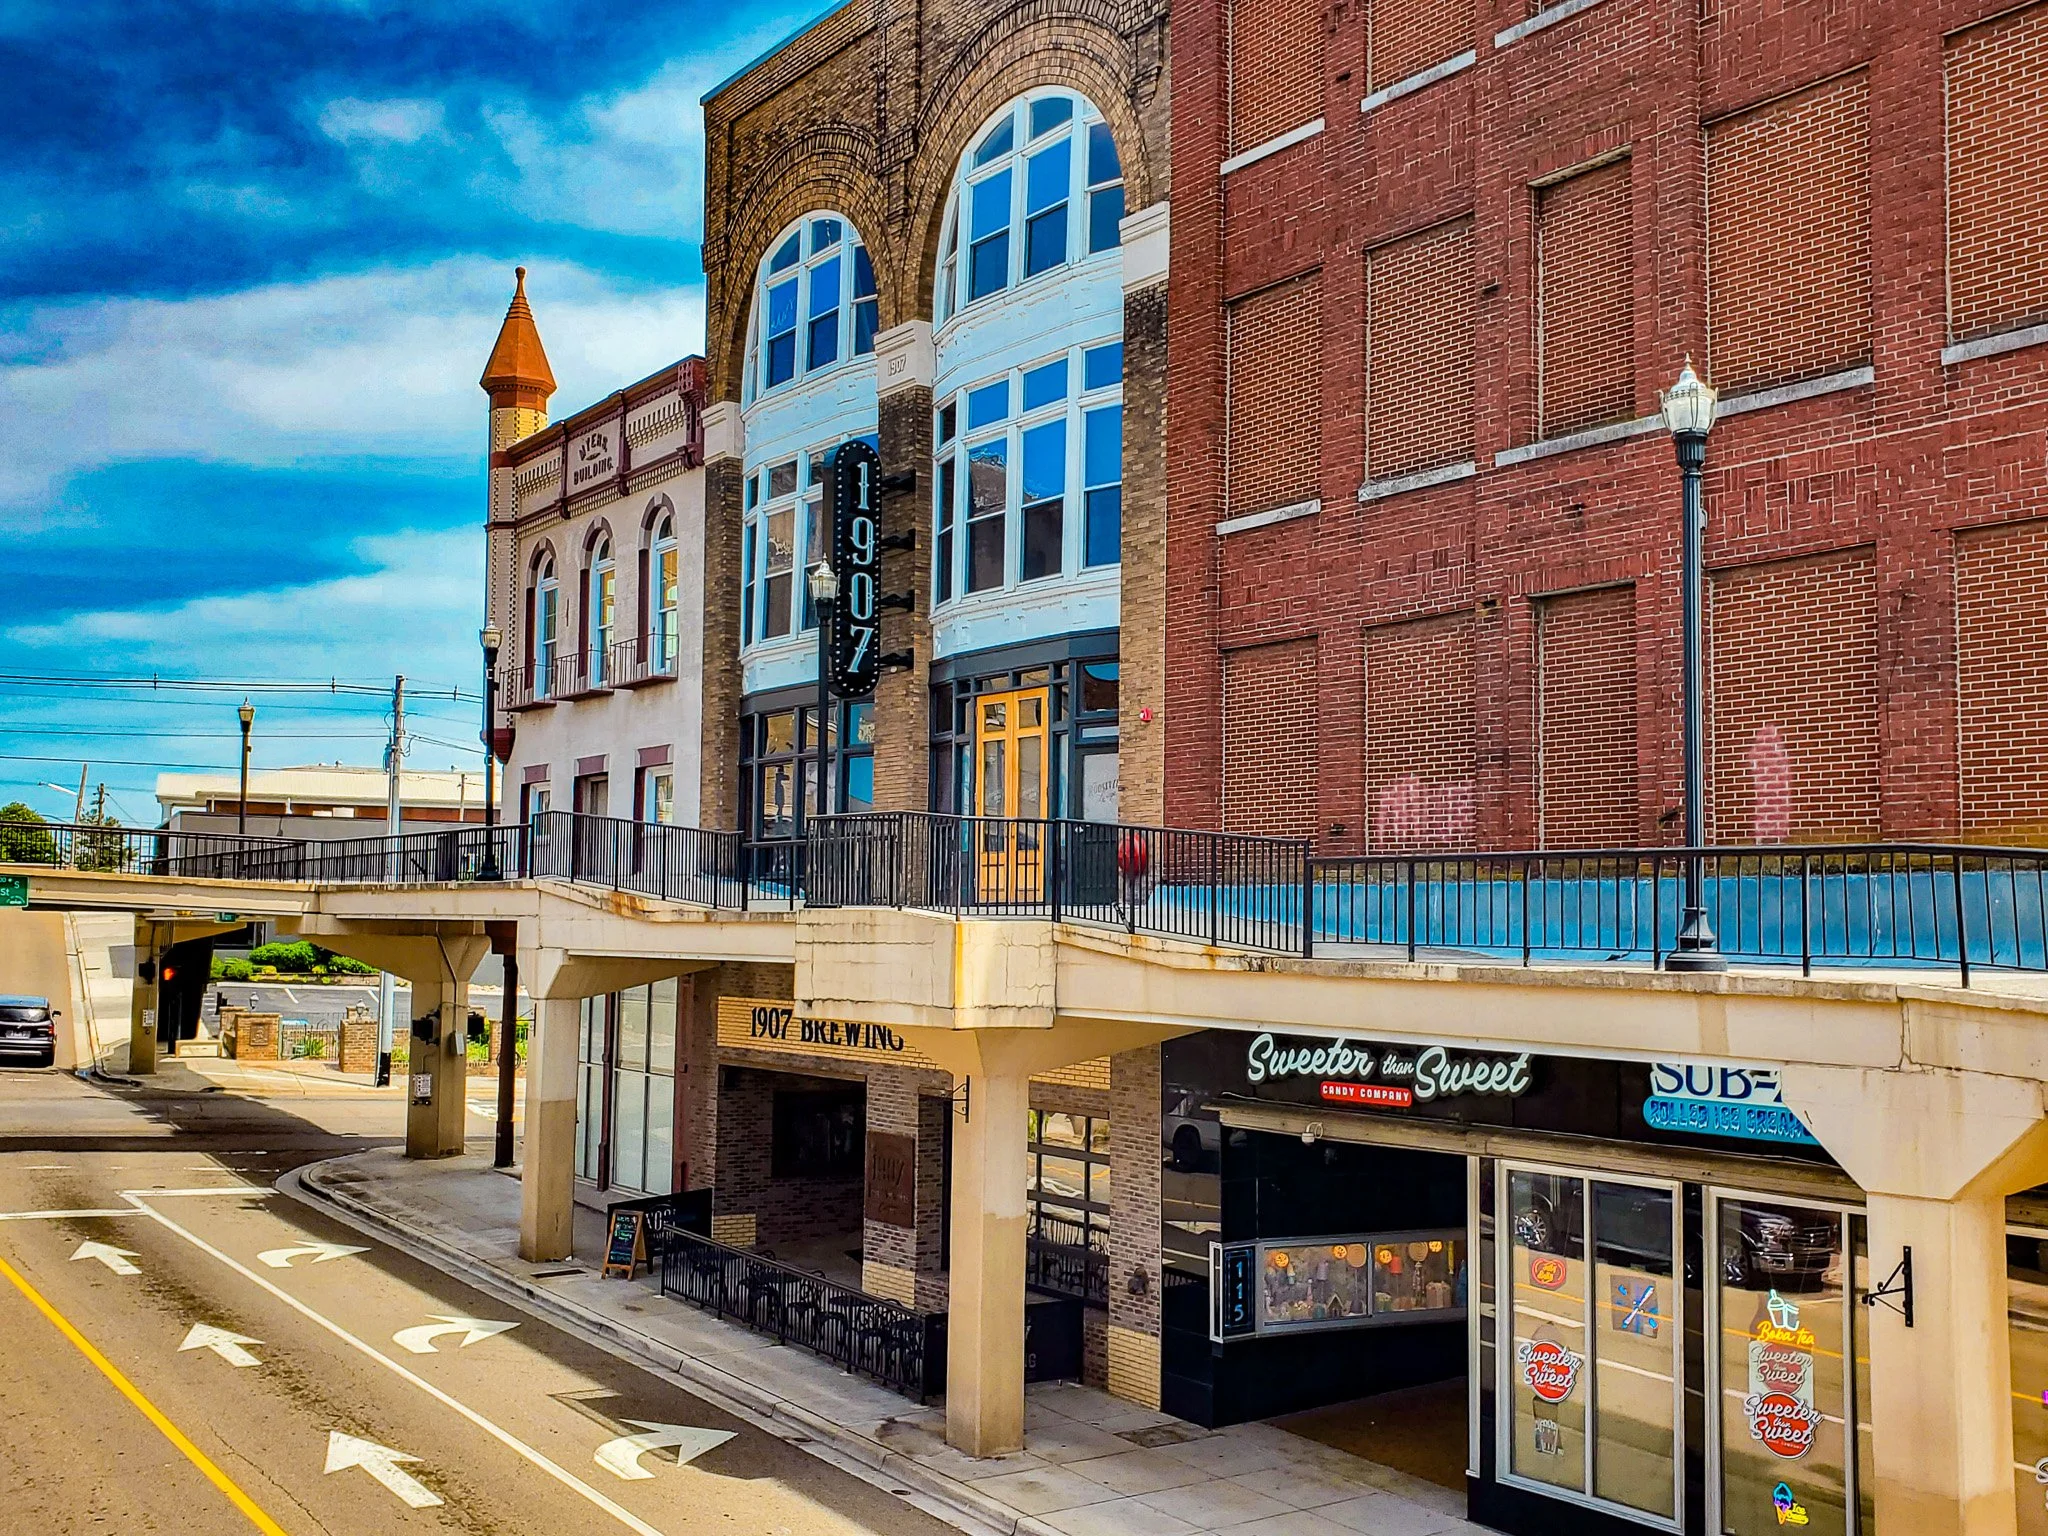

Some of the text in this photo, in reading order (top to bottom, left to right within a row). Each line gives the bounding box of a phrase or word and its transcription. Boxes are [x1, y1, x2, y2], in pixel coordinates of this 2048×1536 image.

[888, 354, 906, 376] 1907
[849, 461, 875, 673] 1907
[751, 1006, 793, 1040] 1907
[1248, 1033, 1530, 1099] Sweeter than Sweet
[1322, 1084, 1410, 1102] CANDY COMPANY
[1650, 1101, 1708, 1129] ROLLED
[1234, 1261, 1244, 1322] 115
[1757, 1320, 1796, 1342] Boba
[1518, 1343, 1582, 1370] Sweeter
[1750, 1345, 1814, 1370] Sweeter
[1524, 1363, 1574, 1388] Sweet
[1757, 1362, 1807, 1385] Sweet
[1744, 1393, 1823, 1424] Sweeter
[1751, 1416, 1814, 1445] Sweet
